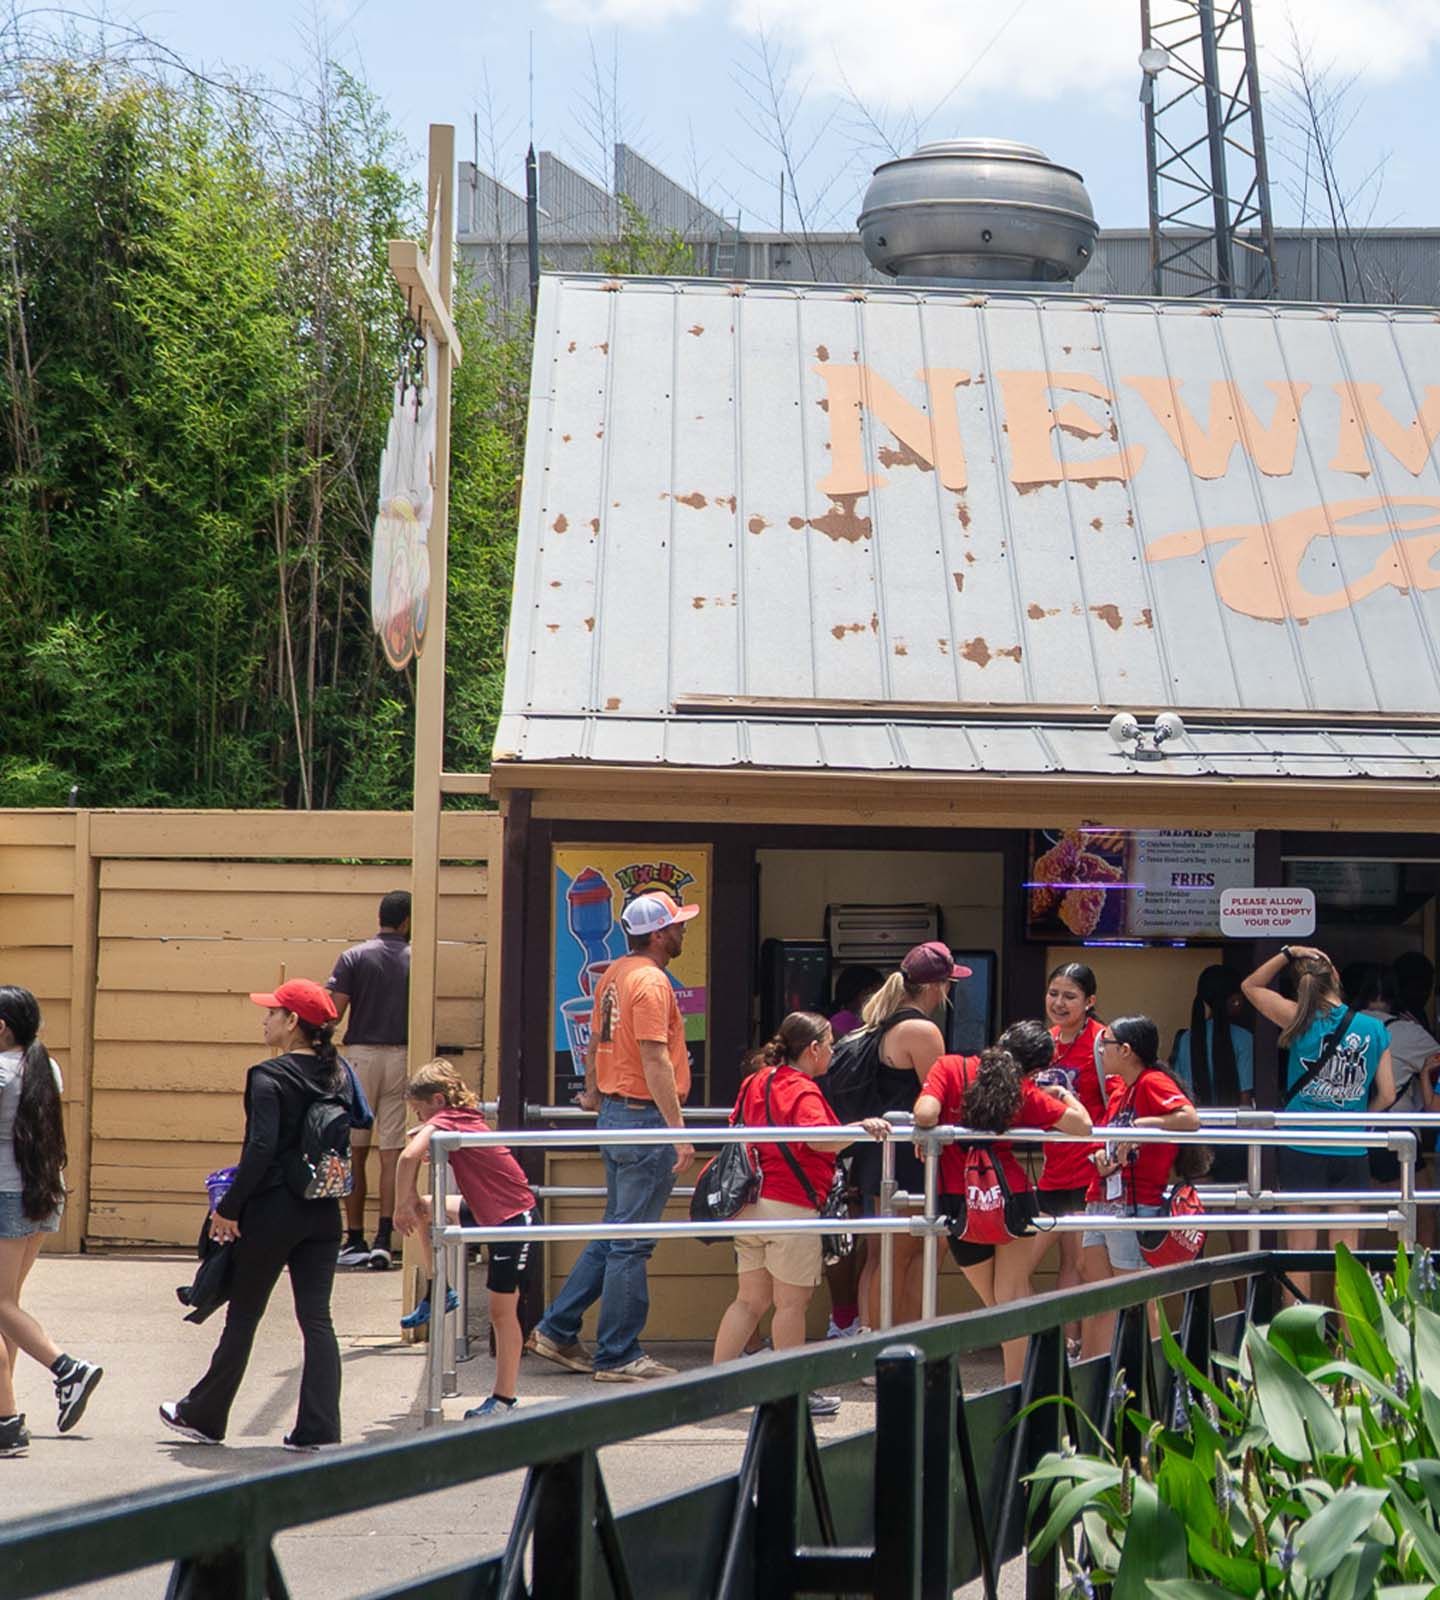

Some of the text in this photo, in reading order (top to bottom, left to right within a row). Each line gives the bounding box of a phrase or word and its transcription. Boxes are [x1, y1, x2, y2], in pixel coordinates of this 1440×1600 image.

[1170, 872, 1215, 887] FRIES
[1270, 897, 1303, 905] ALLOW
[1223, 908, 1263, 916] CASHIER
[1281, 908, 1312, 916] EMPTY
[1244, 918, 1291, 926] YOUR CUP
[967, 1185, 1001, 1204] TMF
